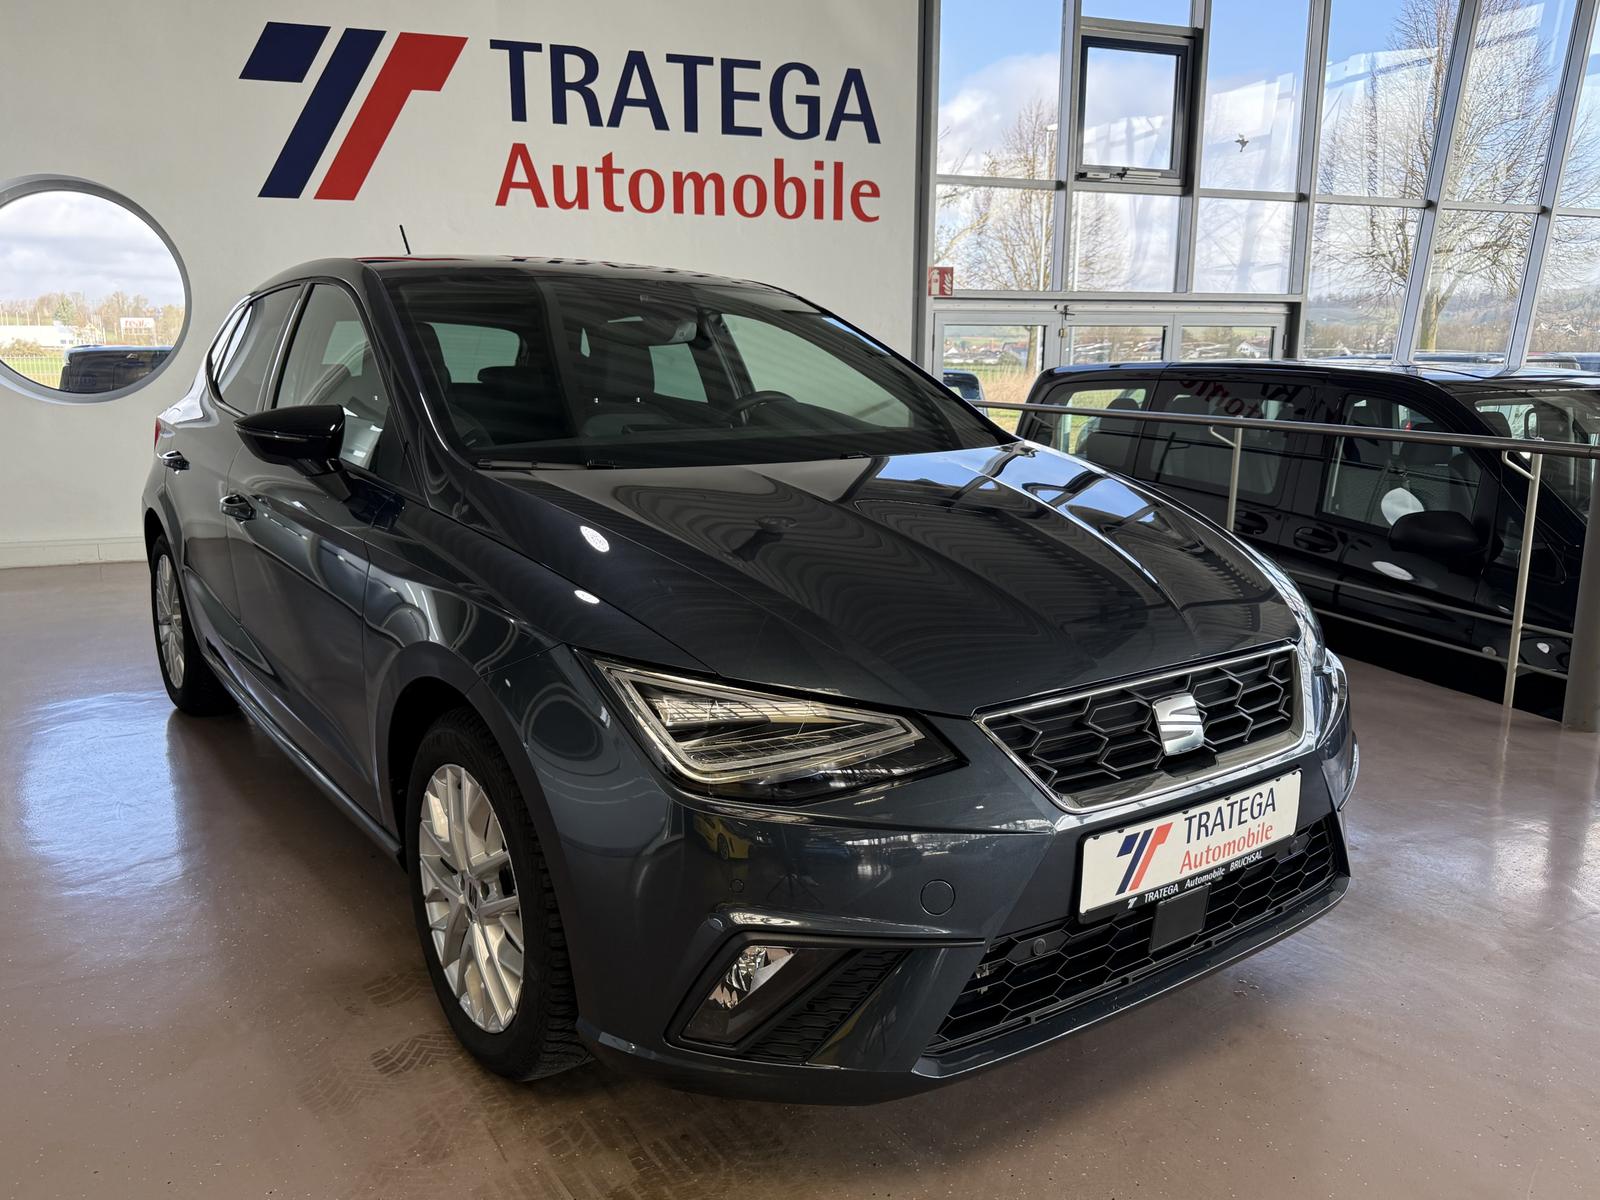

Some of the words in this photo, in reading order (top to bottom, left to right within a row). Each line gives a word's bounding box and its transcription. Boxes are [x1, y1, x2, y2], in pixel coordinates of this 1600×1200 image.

[489, 38, 881, 144] TRATEGA
[495, 142, 881, 223] Automobile
[1184, 787, 1276, 844] TRATEGA
[1179, 821, 1274, 874] Automobile
[1144, 883, 1179, 903] TRATEGA
[1185, 867, 1226, 888] Automobile
[1229, 850, 1263, 871] BRUCHSAL
